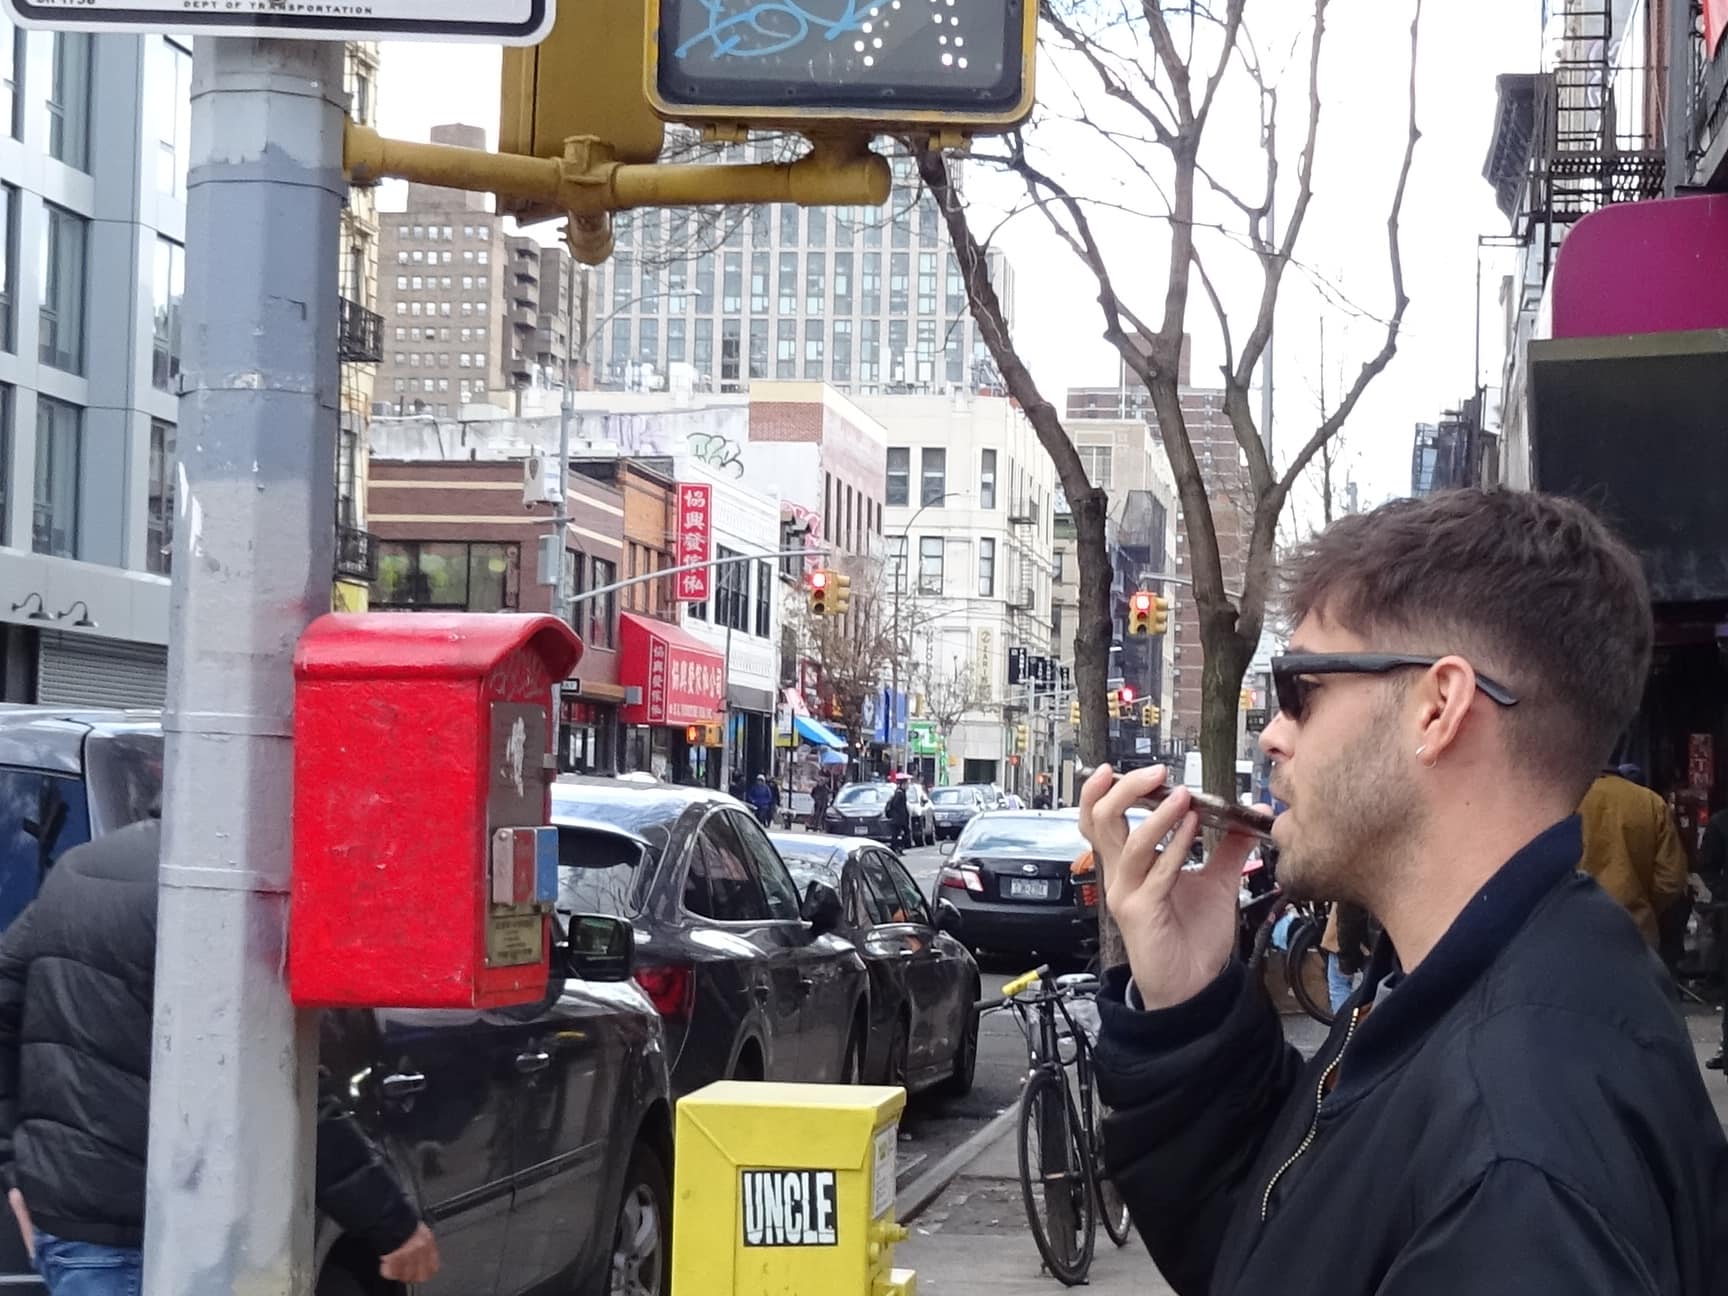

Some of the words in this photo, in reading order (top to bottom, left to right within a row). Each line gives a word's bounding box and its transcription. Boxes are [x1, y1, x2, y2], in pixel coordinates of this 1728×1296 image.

[183, 0, 218, 9] DEPT
[225, 2, 242, 10] OF
[744, 1170, 836, 1246] UNCLE
